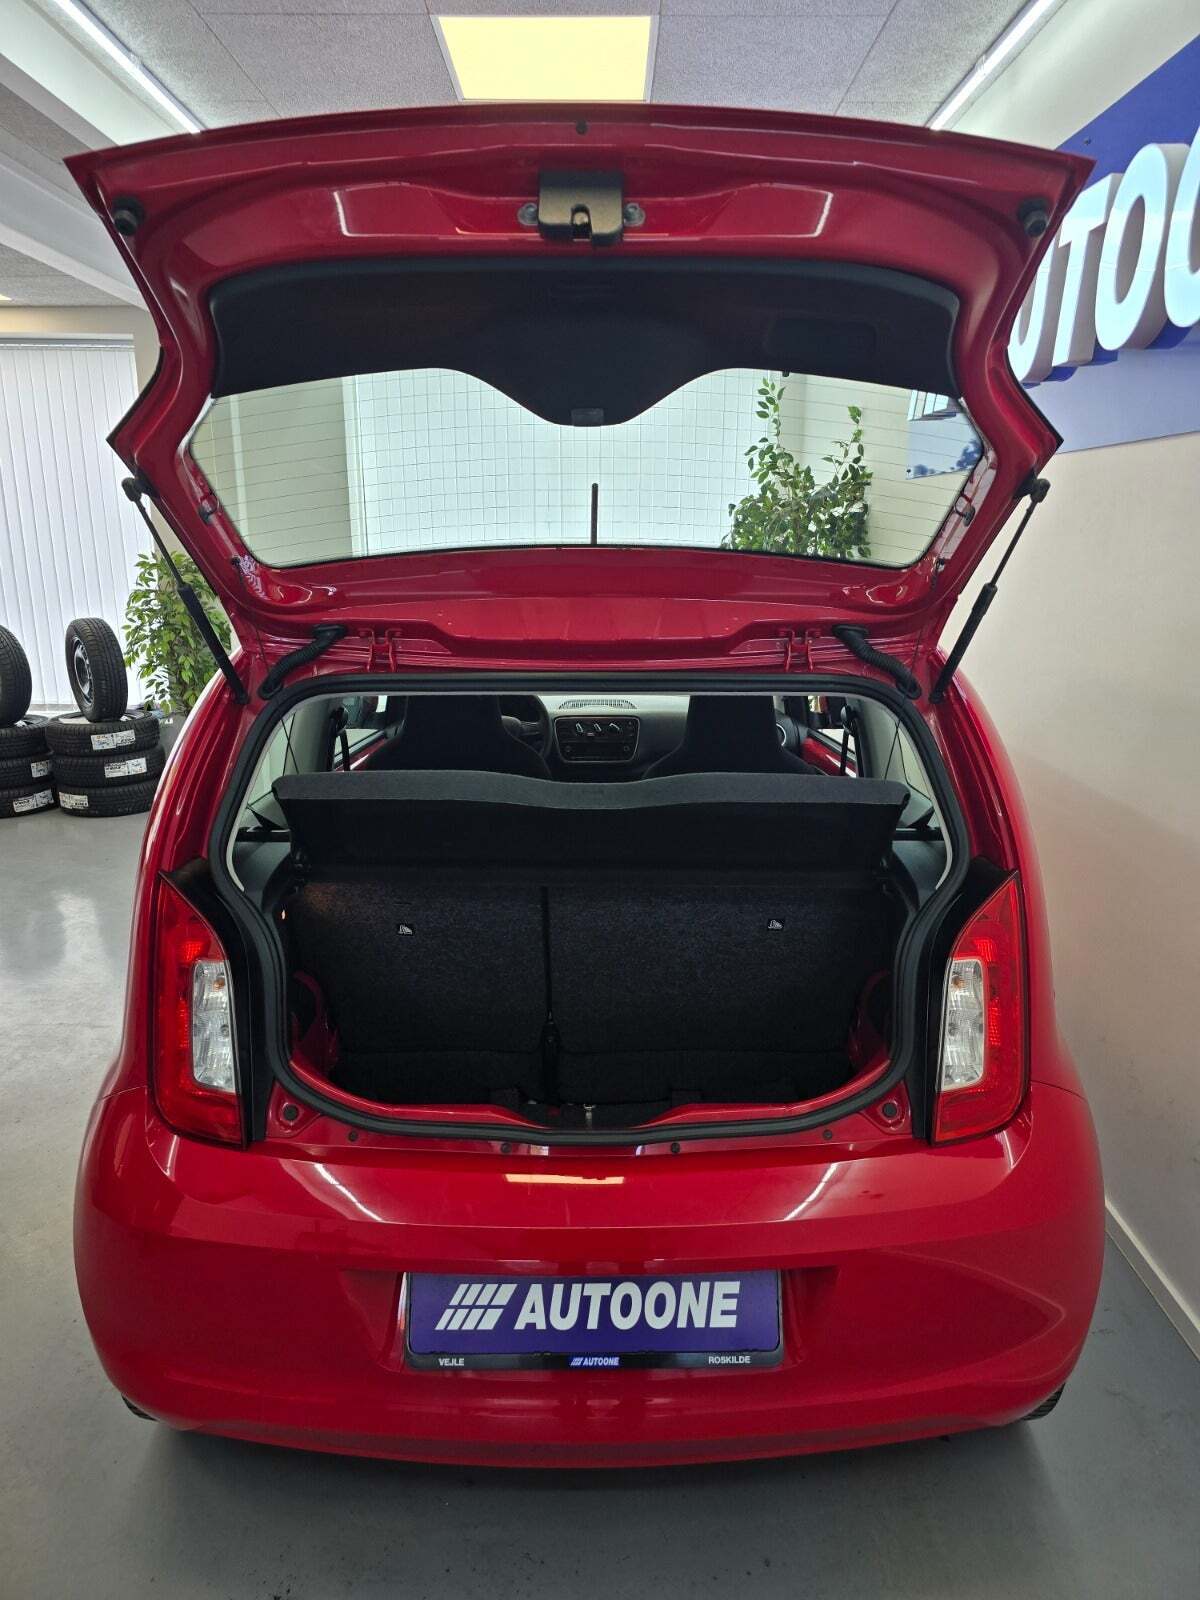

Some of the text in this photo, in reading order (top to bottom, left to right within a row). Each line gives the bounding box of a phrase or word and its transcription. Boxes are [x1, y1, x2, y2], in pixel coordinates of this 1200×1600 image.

[513, 1280, 740, 1331] AUTOONE
[438, 1357, 465, 1367] VEJLE
[582, 1356, 620, 1366] AUTOONE
[708, 1355, 751, 1365] ROSKILDE
